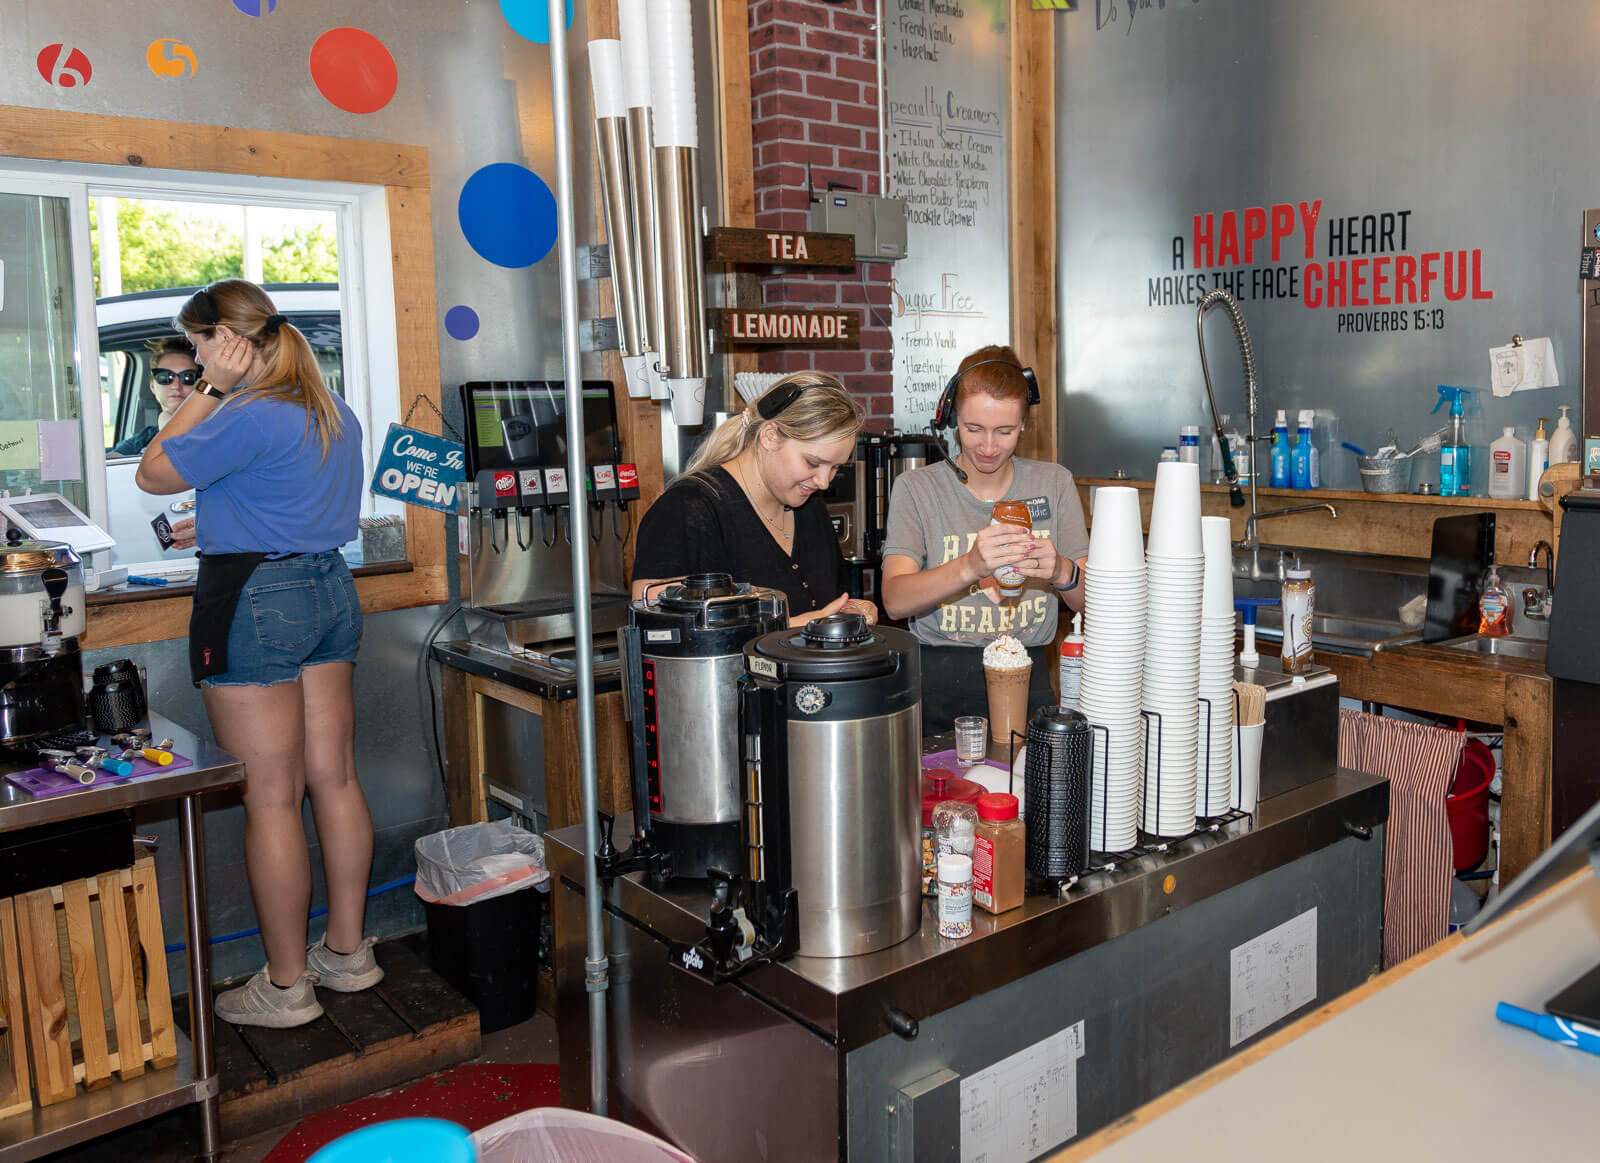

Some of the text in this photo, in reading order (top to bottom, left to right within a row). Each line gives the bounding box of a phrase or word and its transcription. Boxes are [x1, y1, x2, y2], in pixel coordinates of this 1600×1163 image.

[889, 86, 943, 136] pecialty
[968, 135, 993, 154] Cream
[897, 150, 920, 167] White
[922, 151, 960, 168] Chocolate
[896, 170, 916, 186] White
[766, 234, 808, 259] TEA
[1173, 199, 1411, 271] A HAPPY HEART
[1148, 249, 1493, 309] MAKES THE FACE CHEERFUL
[942, 273, 974, 311] Free
[731, 313, 848, 338] LEMONADE
[1338, 309, 1445, 333] PROVERBS 15:13
[906, 330, 933, 348] French
[906, 355, 946, 374] Hazelnut
[906, 375, 938, 394] Caramel
[393, 434, 464, 470] Come In
[406, 460, 439, 478] WE'RE
[380, 468, 456, 506] OPEN
[940, 596, 1048, 633] HEARTS
